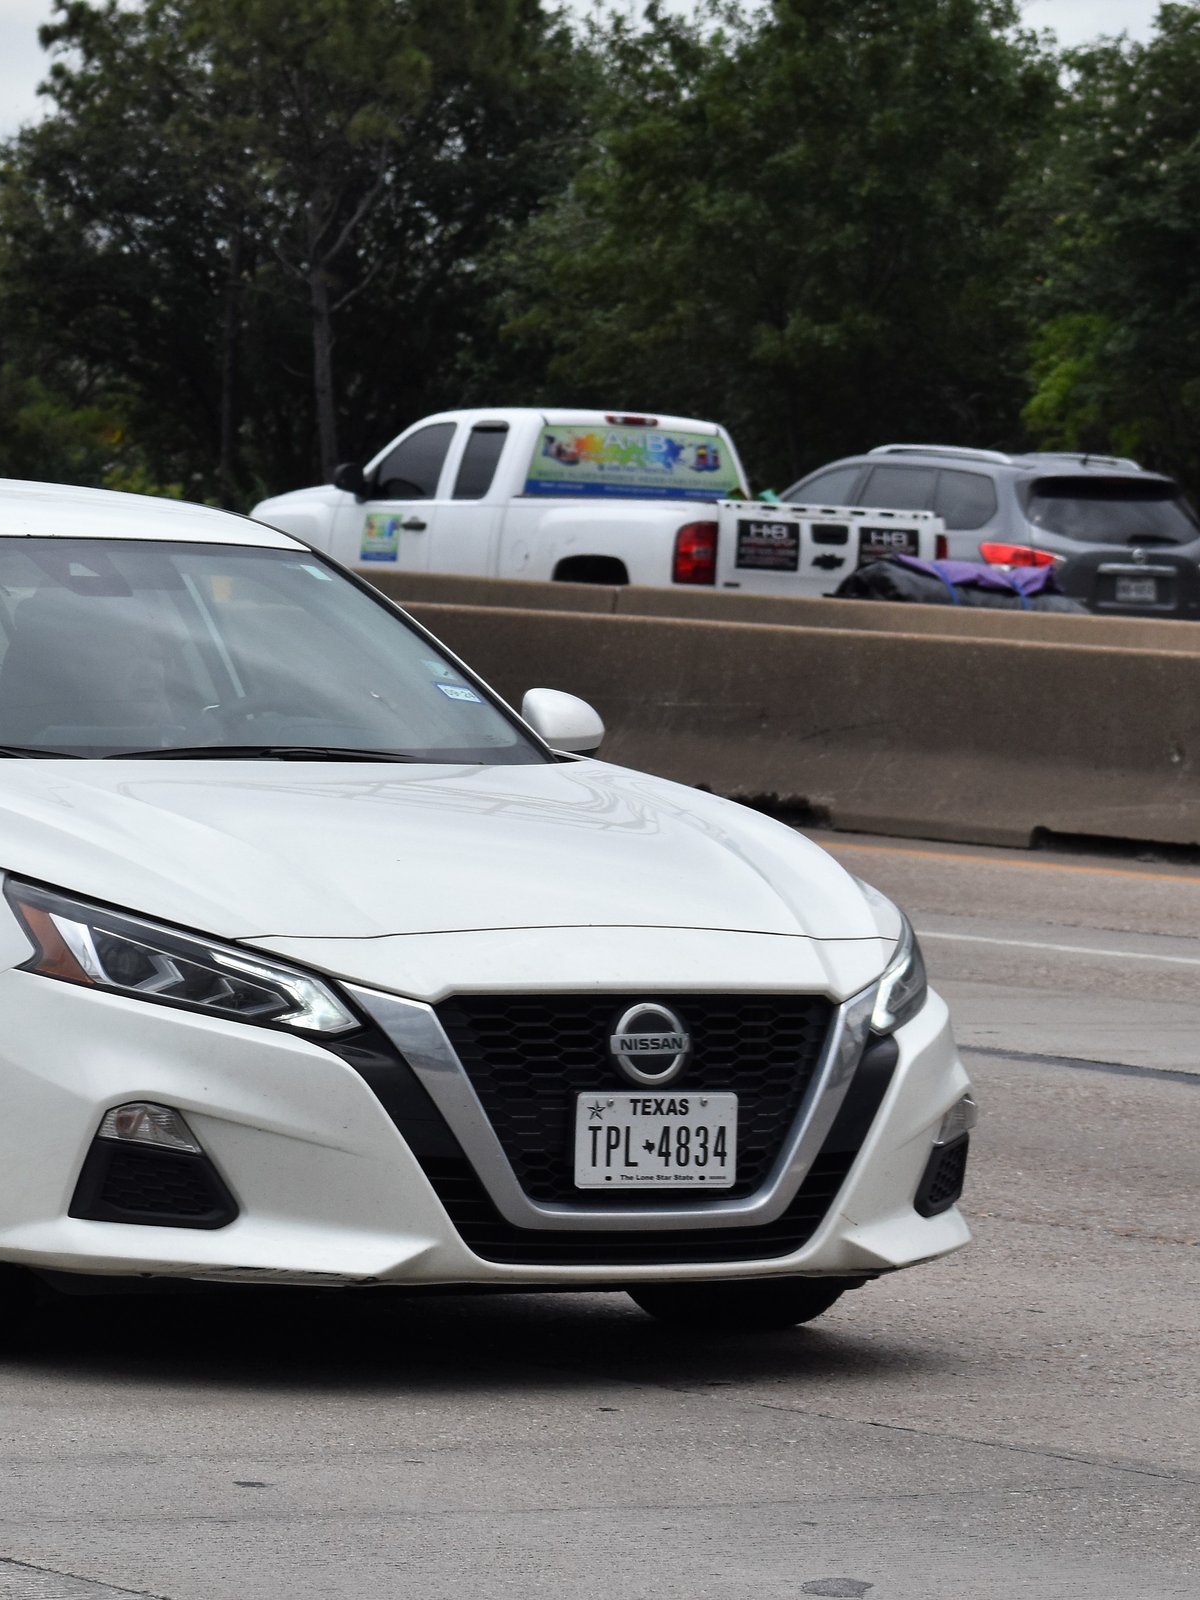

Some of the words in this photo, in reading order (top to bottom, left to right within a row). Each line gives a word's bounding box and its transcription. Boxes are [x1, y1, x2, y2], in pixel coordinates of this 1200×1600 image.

[620, 1037, 683, 1051] NISSAN
[629, 1098, 690, 1116] TEXAS
[588, 1126, 638, 1167] TPL
[657, 1126, 727, 1167] 4834
